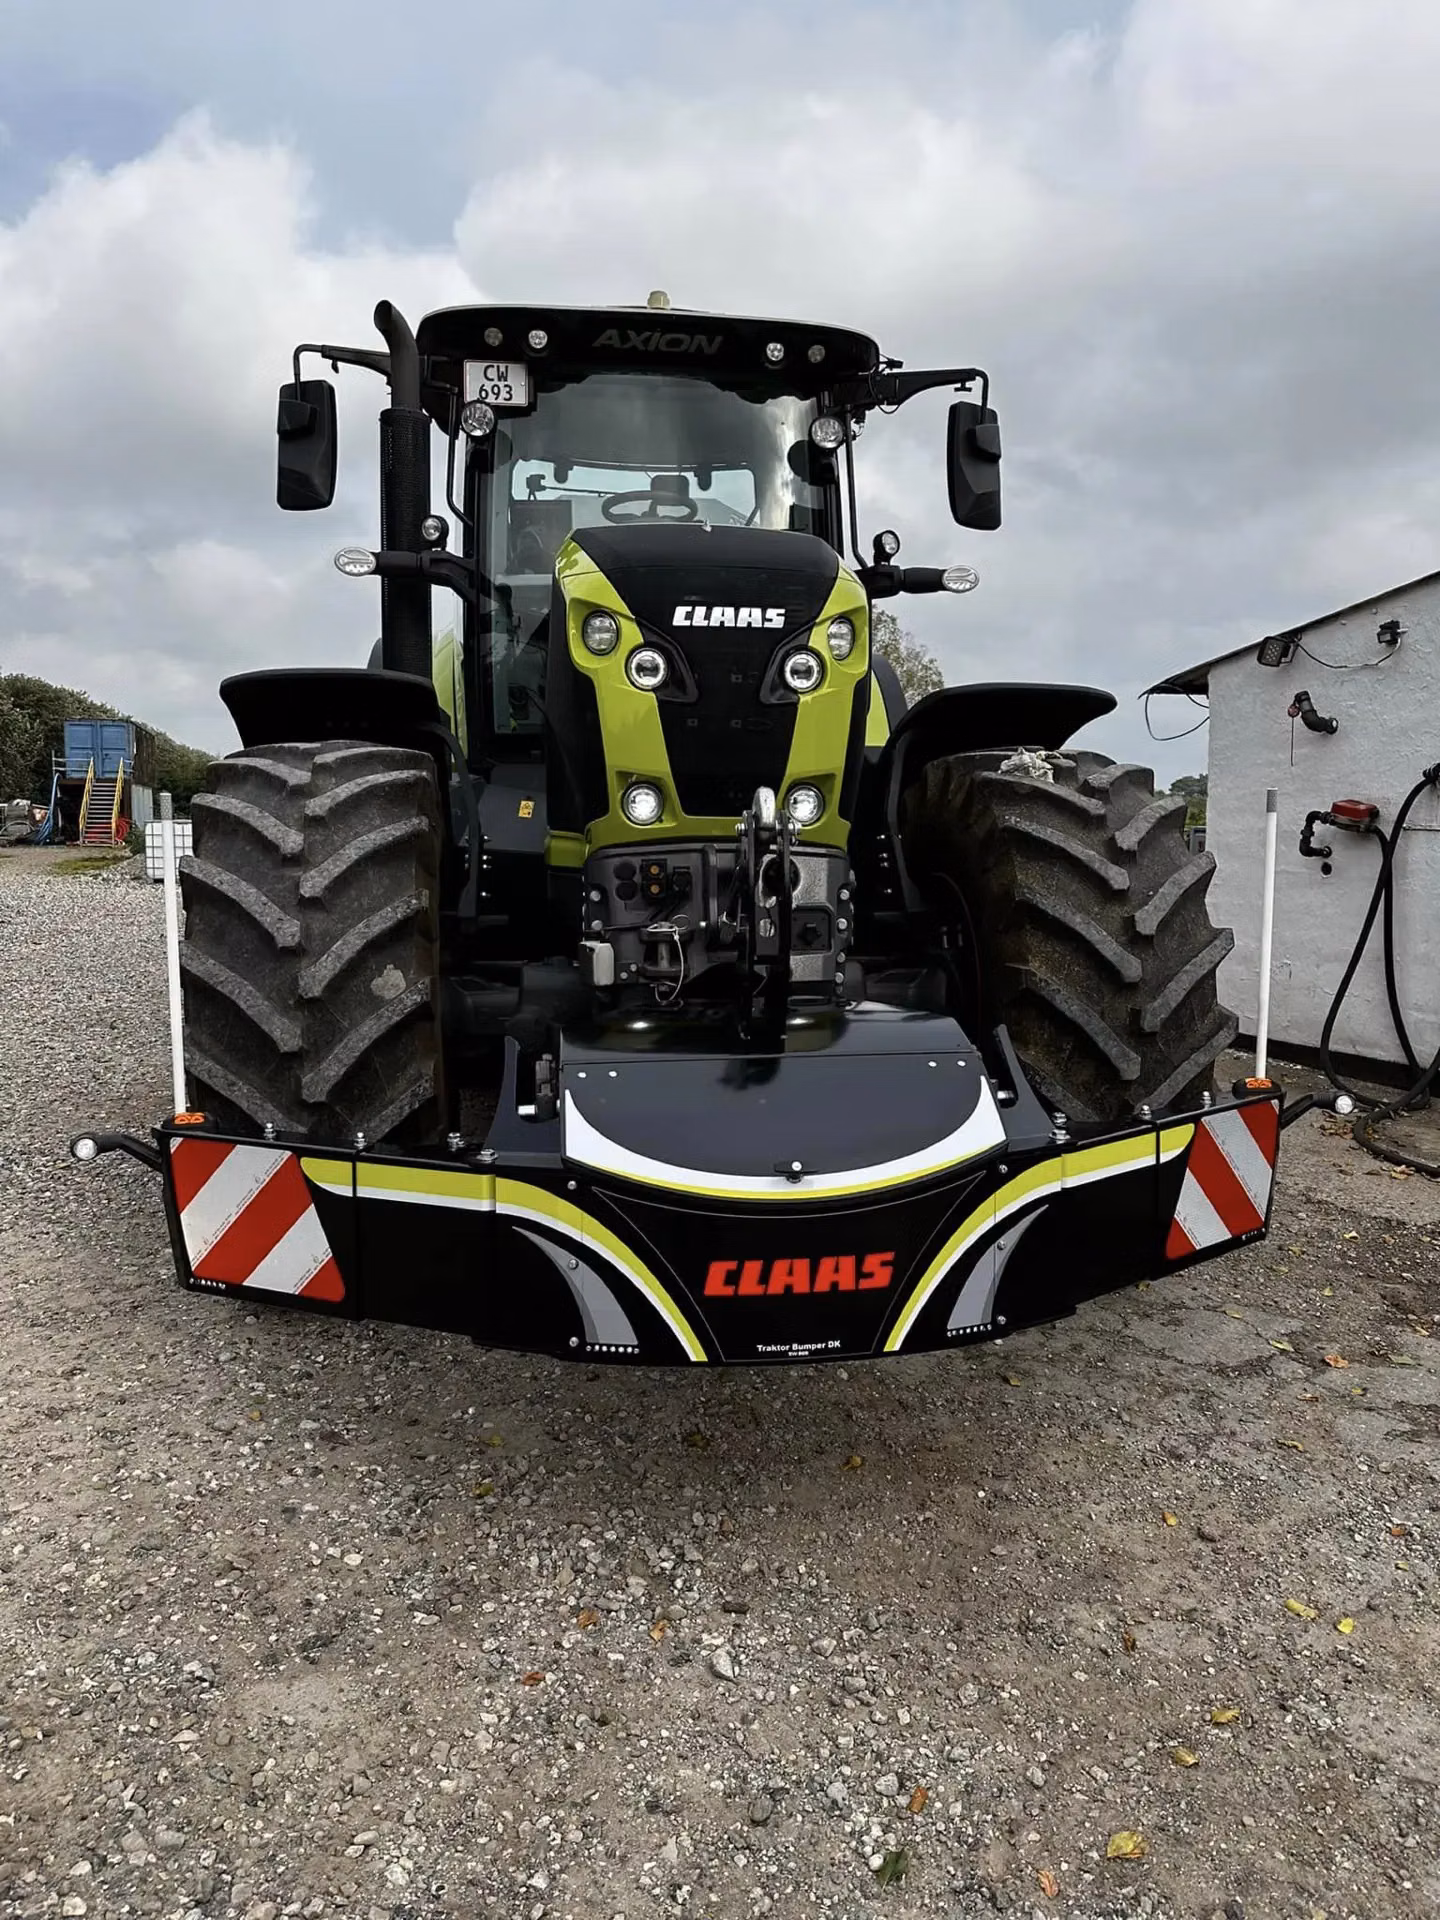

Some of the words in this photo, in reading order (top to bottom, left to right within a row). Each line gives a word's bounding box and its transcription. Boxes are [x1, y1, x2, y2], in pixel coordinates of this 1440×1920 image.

[591, 328, 723, 355] AXION
[483, 364, 509, 382] CW
[479, 383, 513, 401] 693
[672, 606, 786, 628] CLAAS
[703, 1251, 896, 1297] CLAAS
[756, 1344, 790, 1352] Traktor
[792, 1342, 826, 1351] Bumper
[827, 1340, 841, 1348] DK
